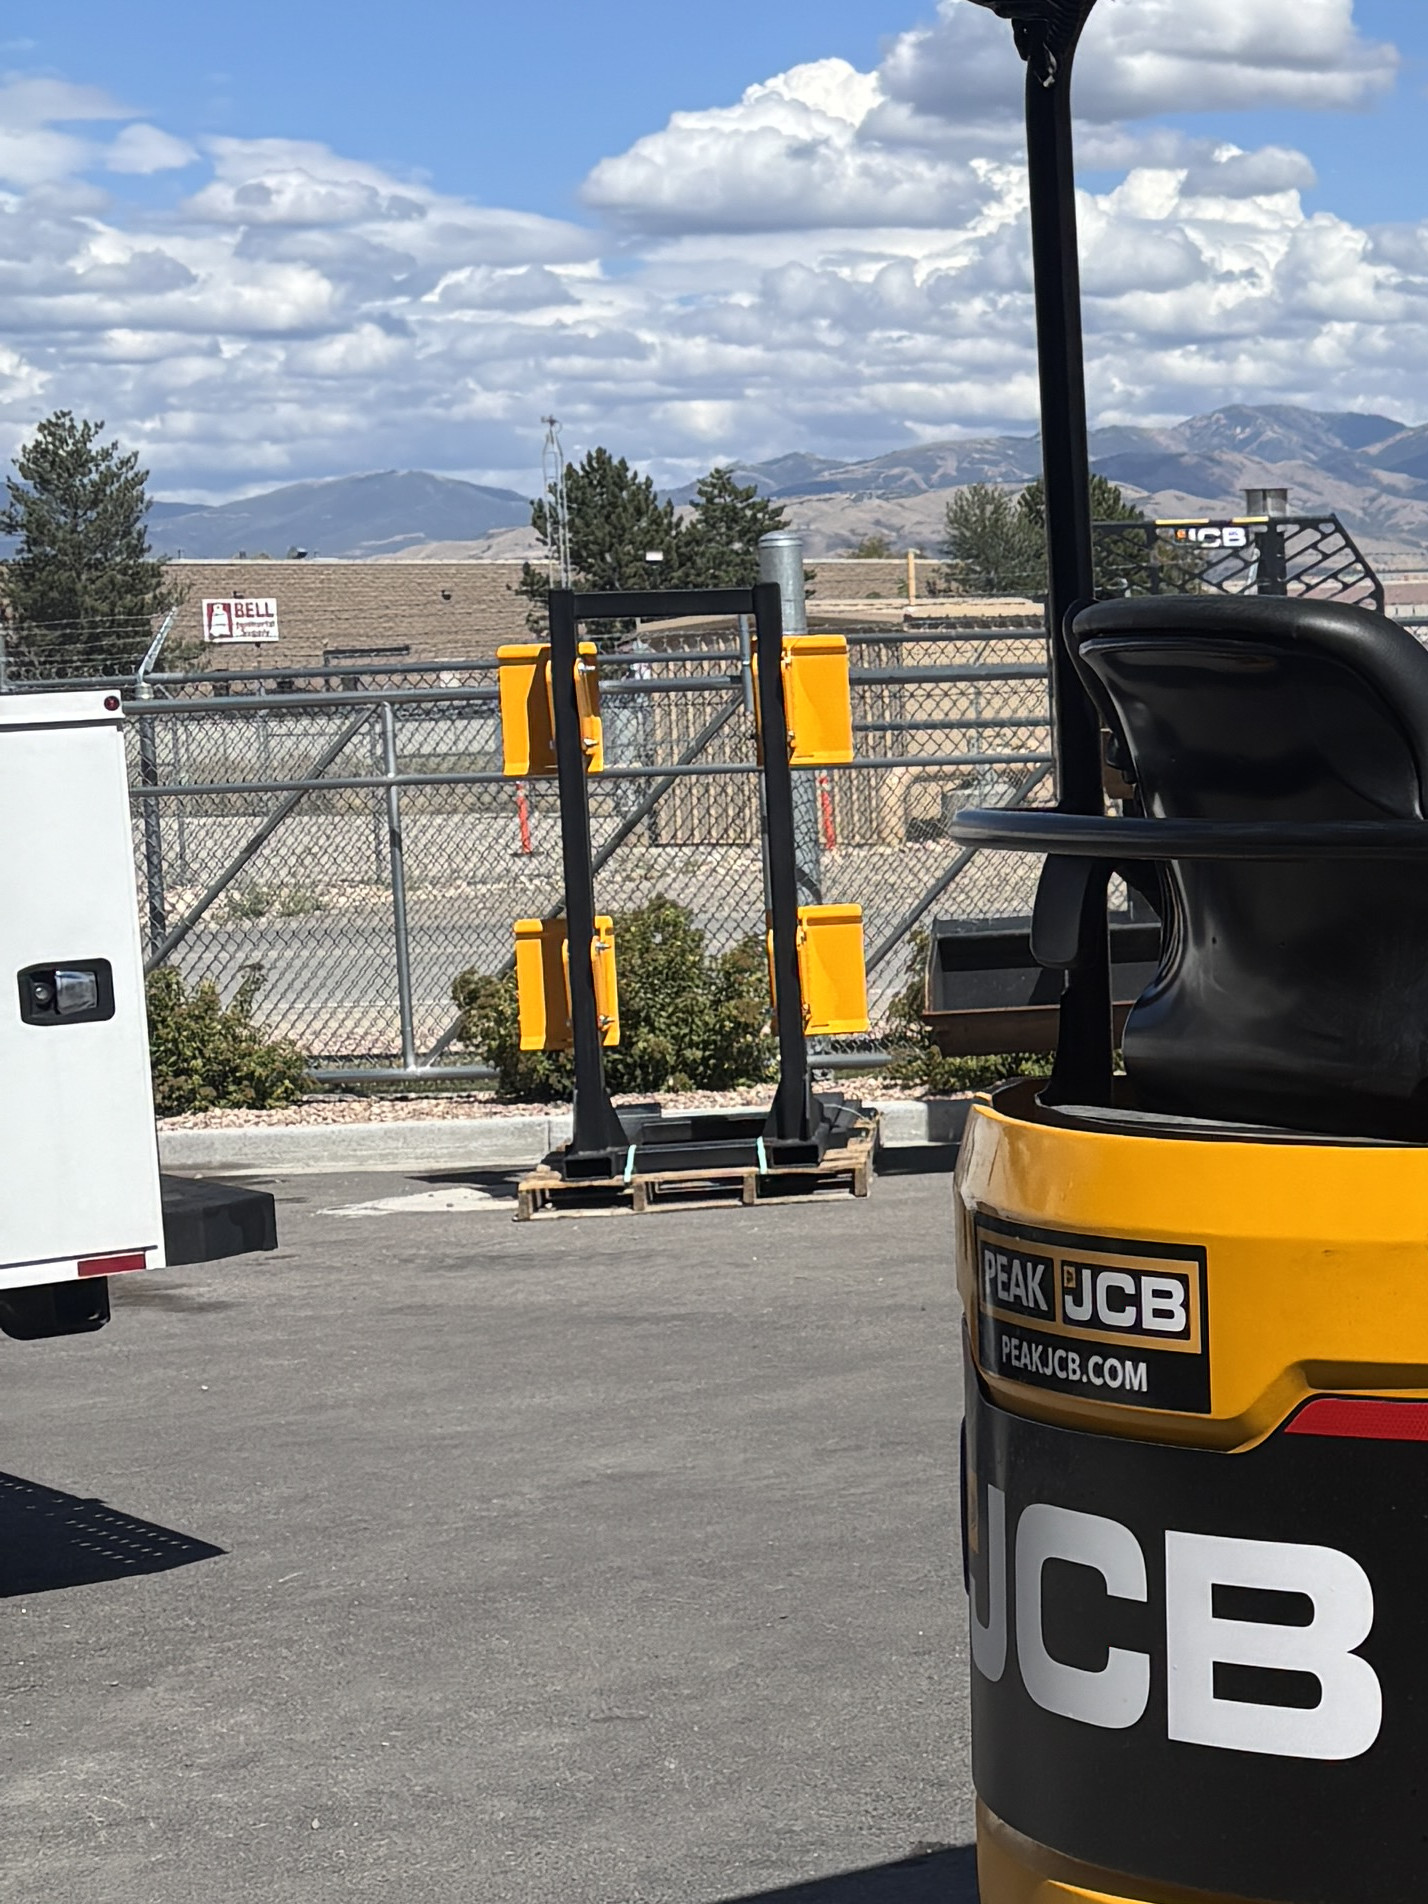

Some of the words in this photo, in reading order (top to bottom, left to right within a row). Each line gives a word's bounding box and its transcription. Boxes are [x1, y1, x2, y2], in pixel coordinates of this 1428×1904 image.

[234, 602, 275, 618] BELL
[984, 1249, 1048, 1311] PEAK
[1064, 1268, 1187, 1332] JCB
[1002, 1334, 1148, 1392] PEAKJCB.COM
[969, 1483, 1383, 1760] JCB
